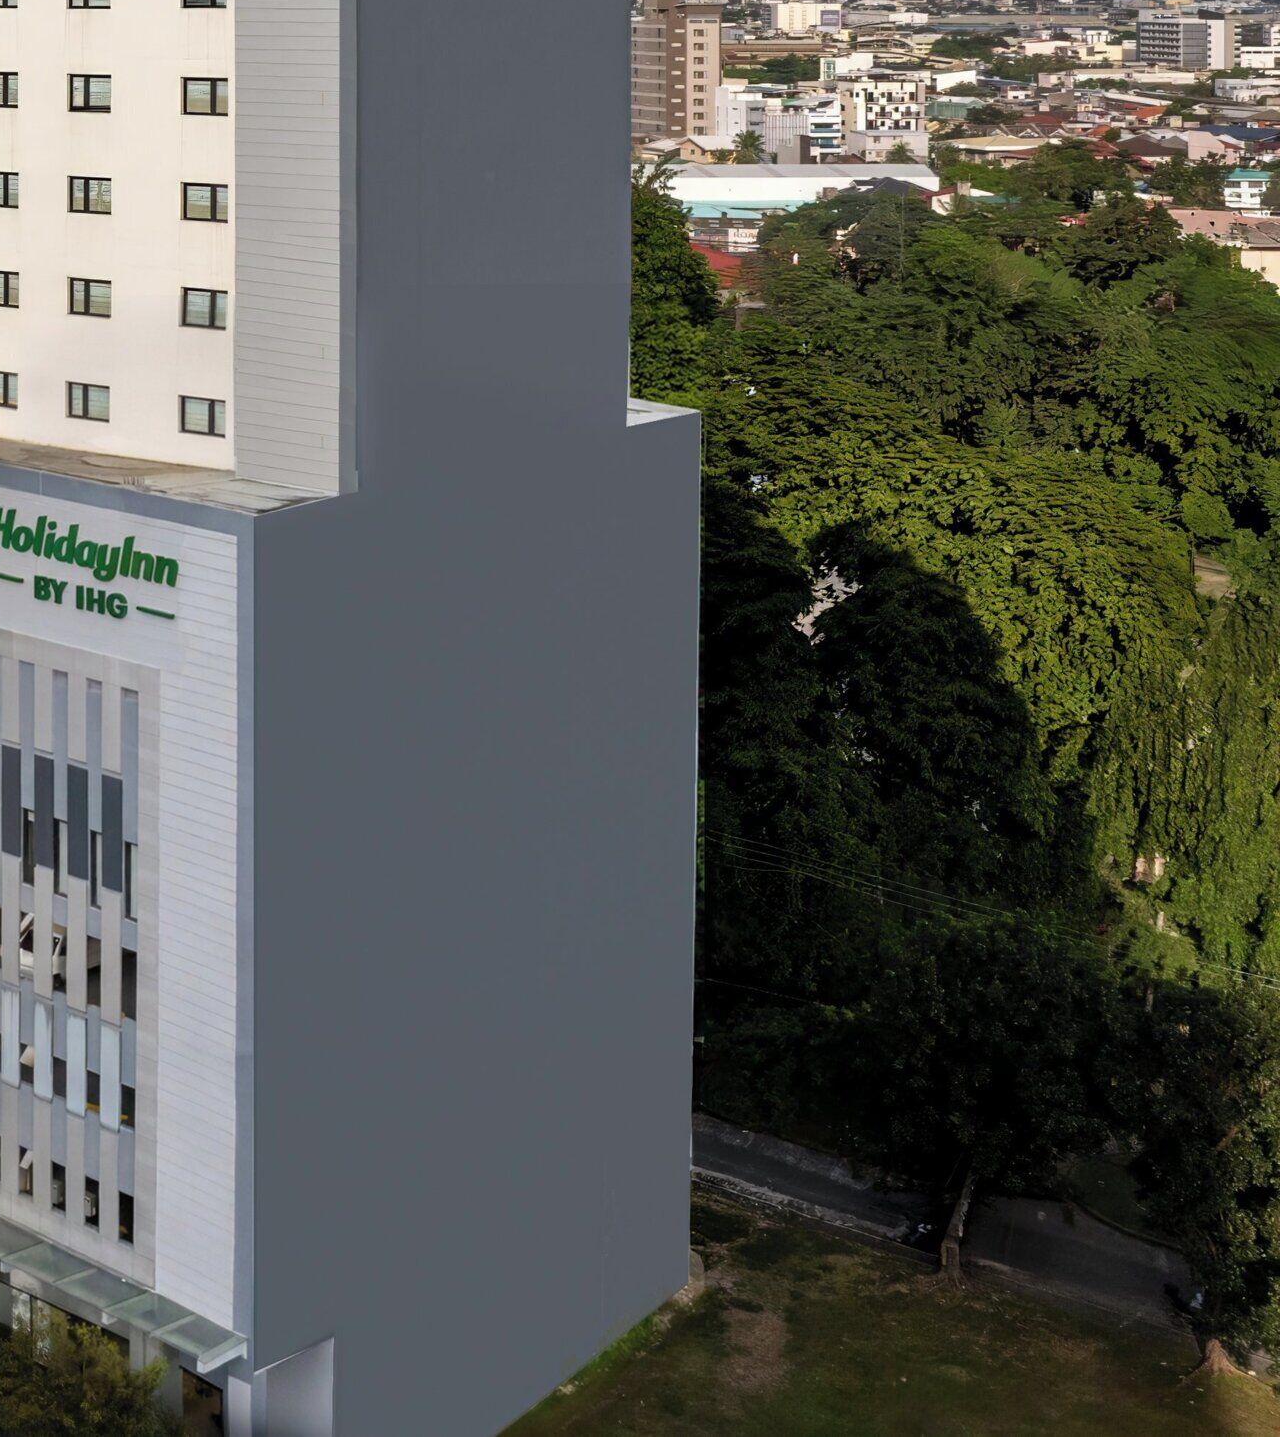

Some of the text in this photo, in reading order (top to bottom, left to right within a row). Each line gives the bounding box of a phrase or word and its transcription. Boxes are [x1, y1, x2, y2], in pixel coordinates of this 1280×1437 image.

[120, 536, 179, 587] Inn
[33, 574, 129, 620] BY IHG
